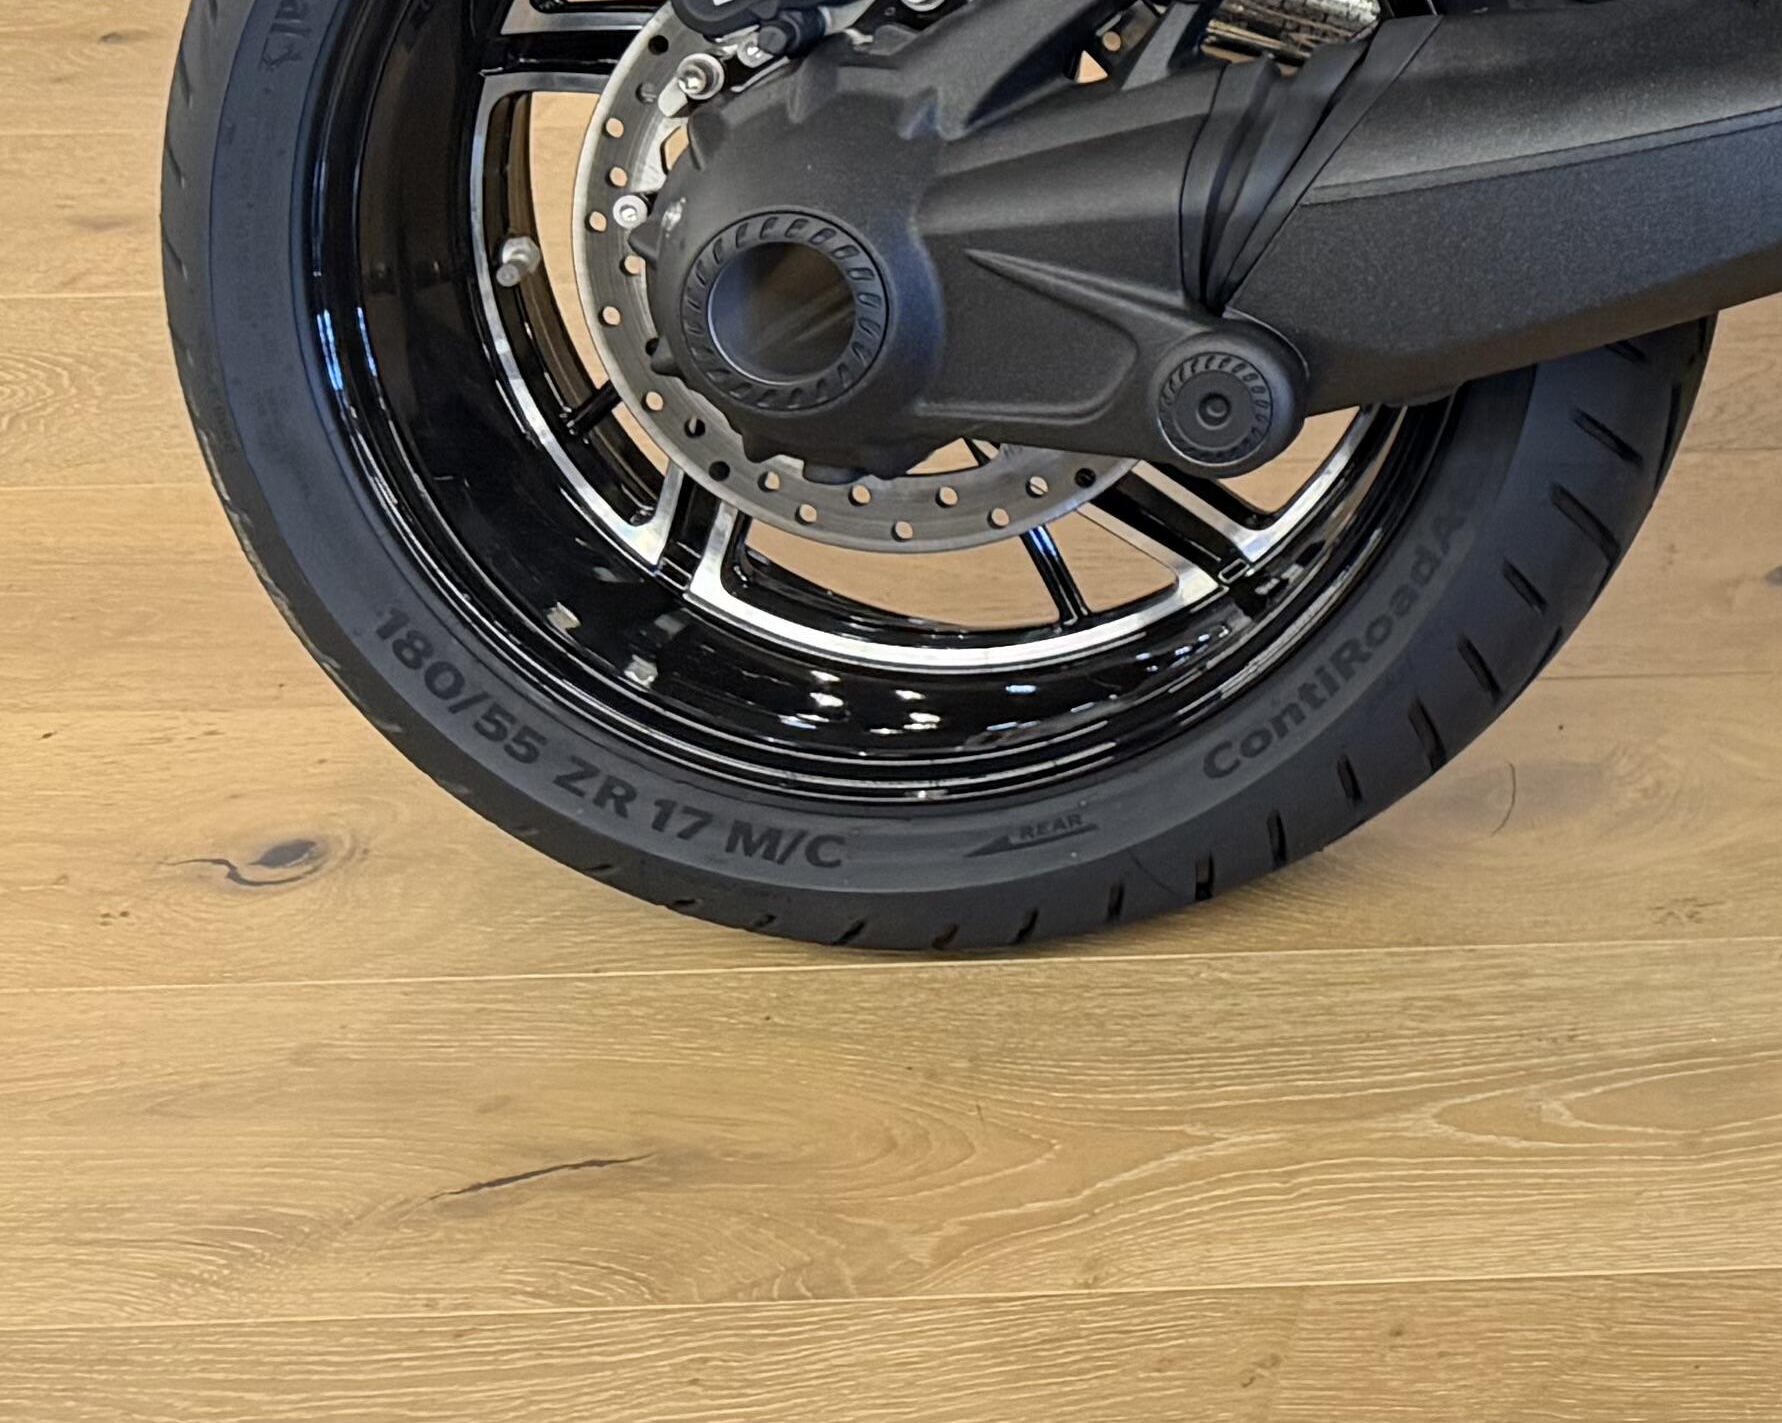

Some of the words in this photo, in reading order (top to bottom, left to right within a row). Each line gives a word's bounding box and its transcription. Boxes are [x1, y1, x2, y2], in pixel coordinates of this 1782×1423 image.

[373, 605, 545, 764] 180/55
[553, 762, 636, 819] ZR
[652, 797, 714, 841] 17
[725, 820, 847, 870] M/C
[1018, 812, 1083, 842] REAR
